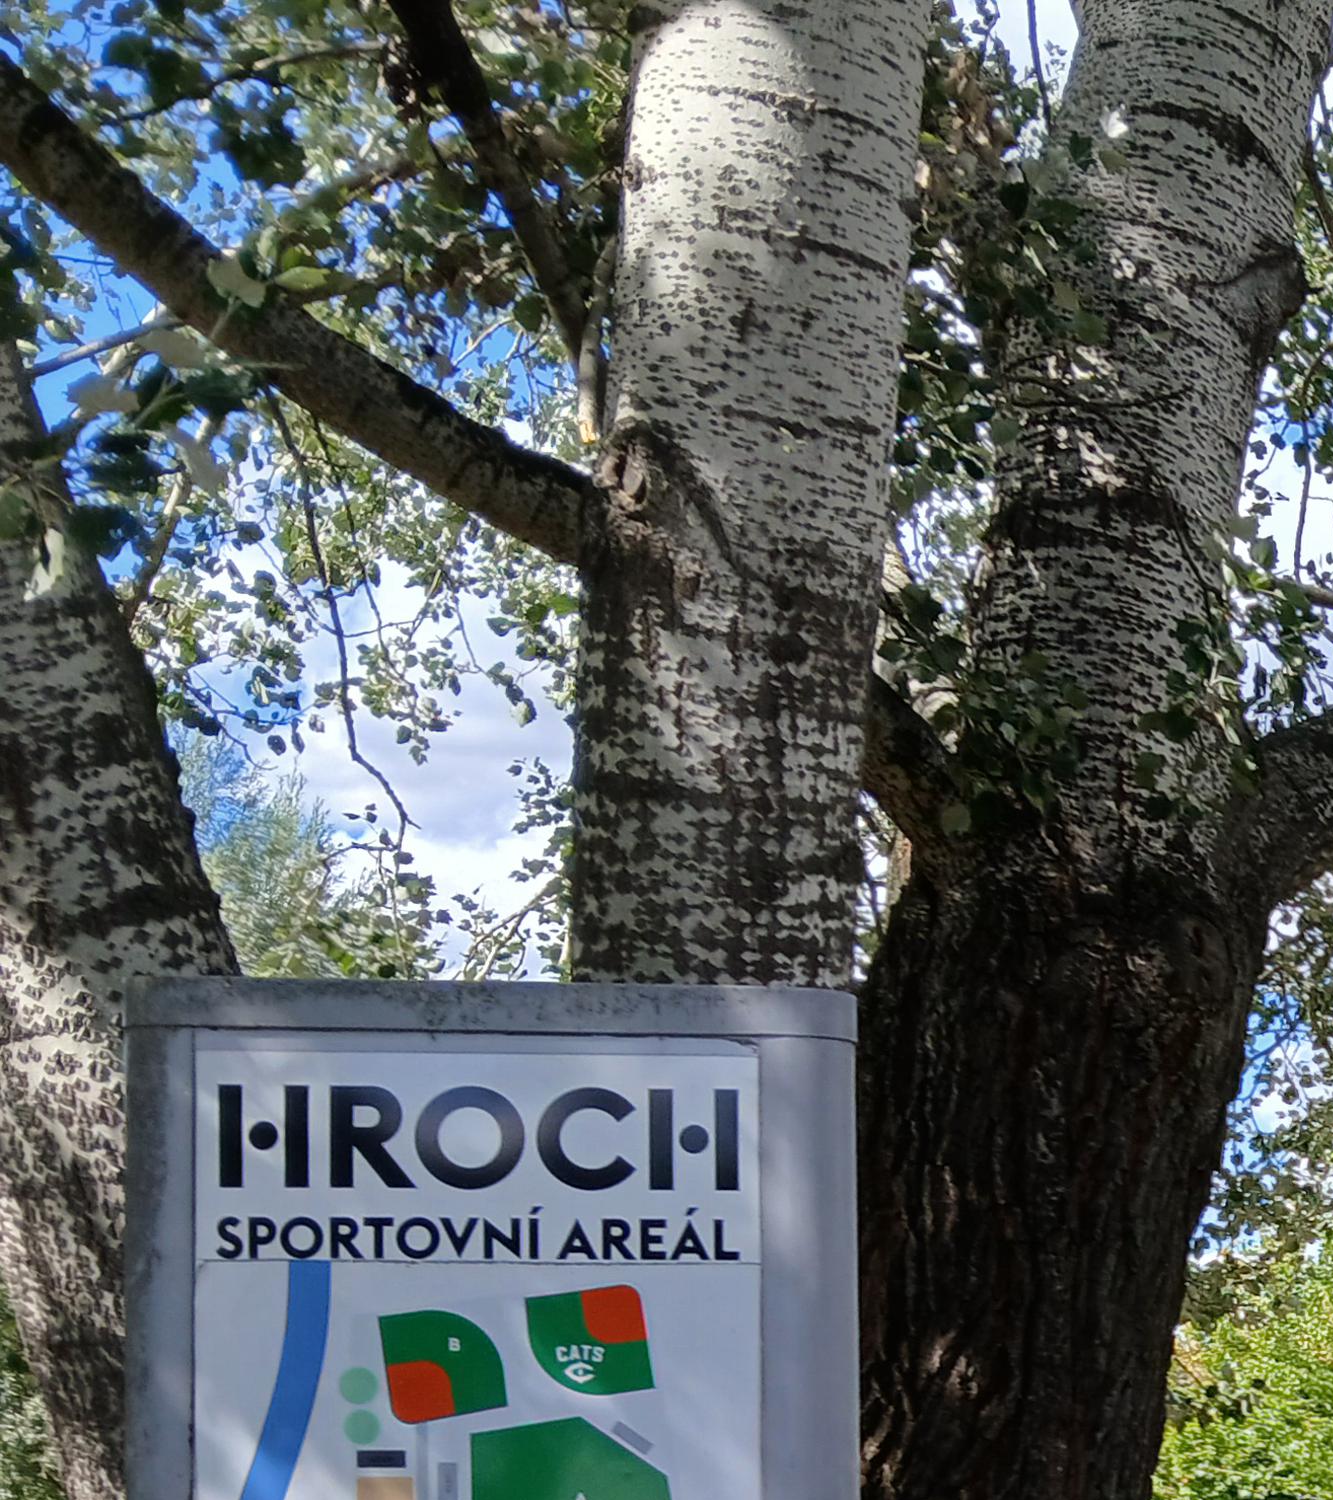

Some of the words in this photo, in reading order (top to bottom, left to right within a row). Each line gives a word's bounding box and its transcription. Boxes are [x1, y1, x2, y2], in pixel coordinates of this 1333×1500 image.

[218, 1085, 739, 1191] HROCH
[217, 1206, 542, 1260] SPORTOVNÍ
[558, 1207, 739, 1260] AREÁL
[447, 1337, 461, 1352] B
[555, 1344, 605, 1362] CATS
